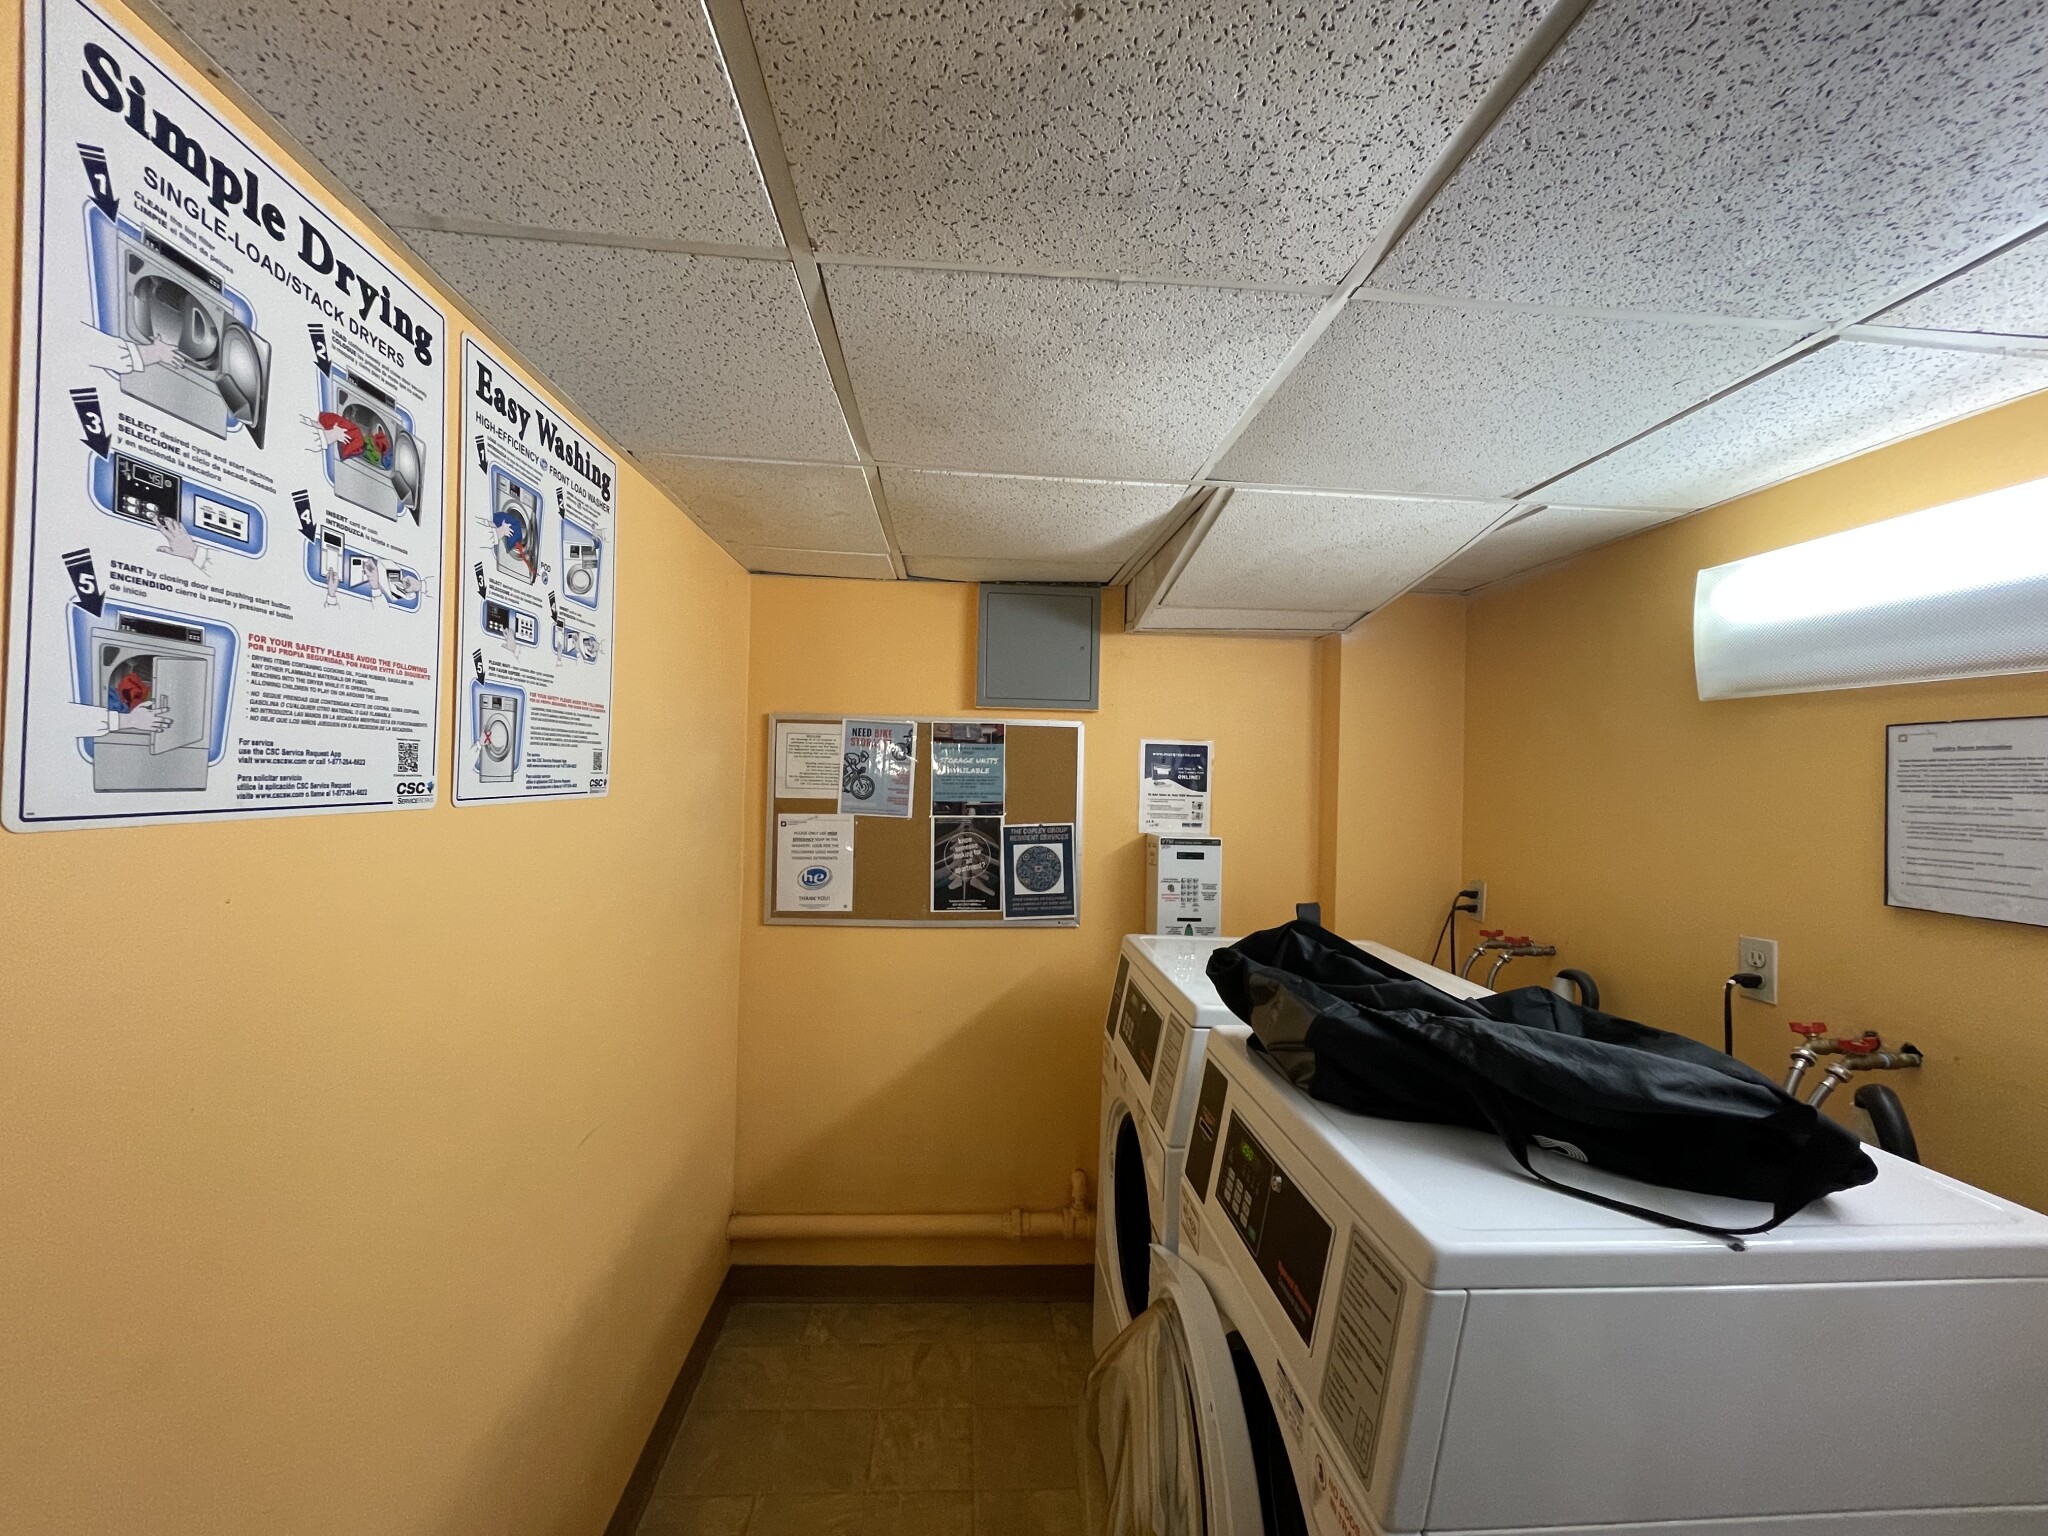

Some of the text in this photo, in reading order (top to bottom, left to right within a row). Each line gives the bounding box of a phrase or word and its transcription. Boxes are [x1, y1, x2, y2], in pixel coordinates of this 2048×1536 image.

[94, 174, 108, 195] 1
[82, 41, 434, 367] Simple Drying
[134, 190, 167, 218] CLEAN
[134, 201, 167, 229] LIMPIE
[143, 166, 406, 369] SINGLE-LOAD/STACK DRYERS
[317, 342, 326, 360] 2
[85, 412, 101, 434] 3
[475, 359, 531, 441] Easy
[535, 409, 612, 502] Washing
[118, 412, 274, 484] SELECT desired cycle and start machine
[480, 450, 485, 461] 1
[117, 436, 222, 482] y en encienda la secadora
[118, 424, 277, 495] SELECCIONE el ciclo de secado deseado
[475, 411, 540, 464] HIGH-EFFICIENCY
[549, 465, 570, 486] FRONT
[571, 480, 587, 498] LOAD
[587, 492, 610, 514] WASHER
[301, 509, 311, 525] 4
[326, 510, 348, 522] INSERT
[326, 518, 364, 538] INTRODUZCA
[78, 573, 95, 594] 5
[109, 583, 147, 598] de inicio
[110, 560, 291, 610] START by closing door and pushing start button
[478, 575, 483, 587] 3
[110, 571, 173, 592] ENCIENDIDO
[175, 588, 198, 599] cierre
[199, 592, 207, 600] la
[208, 595, 232, 607] puerta
[232, 601, 237, 609] y
[238, 602, 267, 615] presione
[248, 633, 427, 673] FOR YOUR SAFETY PLEASE AVOID THE FOLLOWING
[248, 643, 264, 651] POR
[266, 645, 276, 654] SU
[279, 648, 304, 659] PROPIA
[306, 653, 345, 666] SEGURIDAD,
[360, 663, 378, 671] FAVOR
[477, 662, 483, 674] 5
[239, 738, 250, 746] For
[852, 728, 893, 738] NEED BIKE
[305, 749, 330, 758] Request
[330, 750, 342, 758] App
[331, 782, 352, 790] Request
[397, 782, 425, 794] CSC
[590, 779, 603, 787] CSC
[954, 851, 974, 859] looking
[803, 870, 825, 883] he
[954, 862, 986, 874] apartment?
[1329, 1477, 1338, 1500] NO
